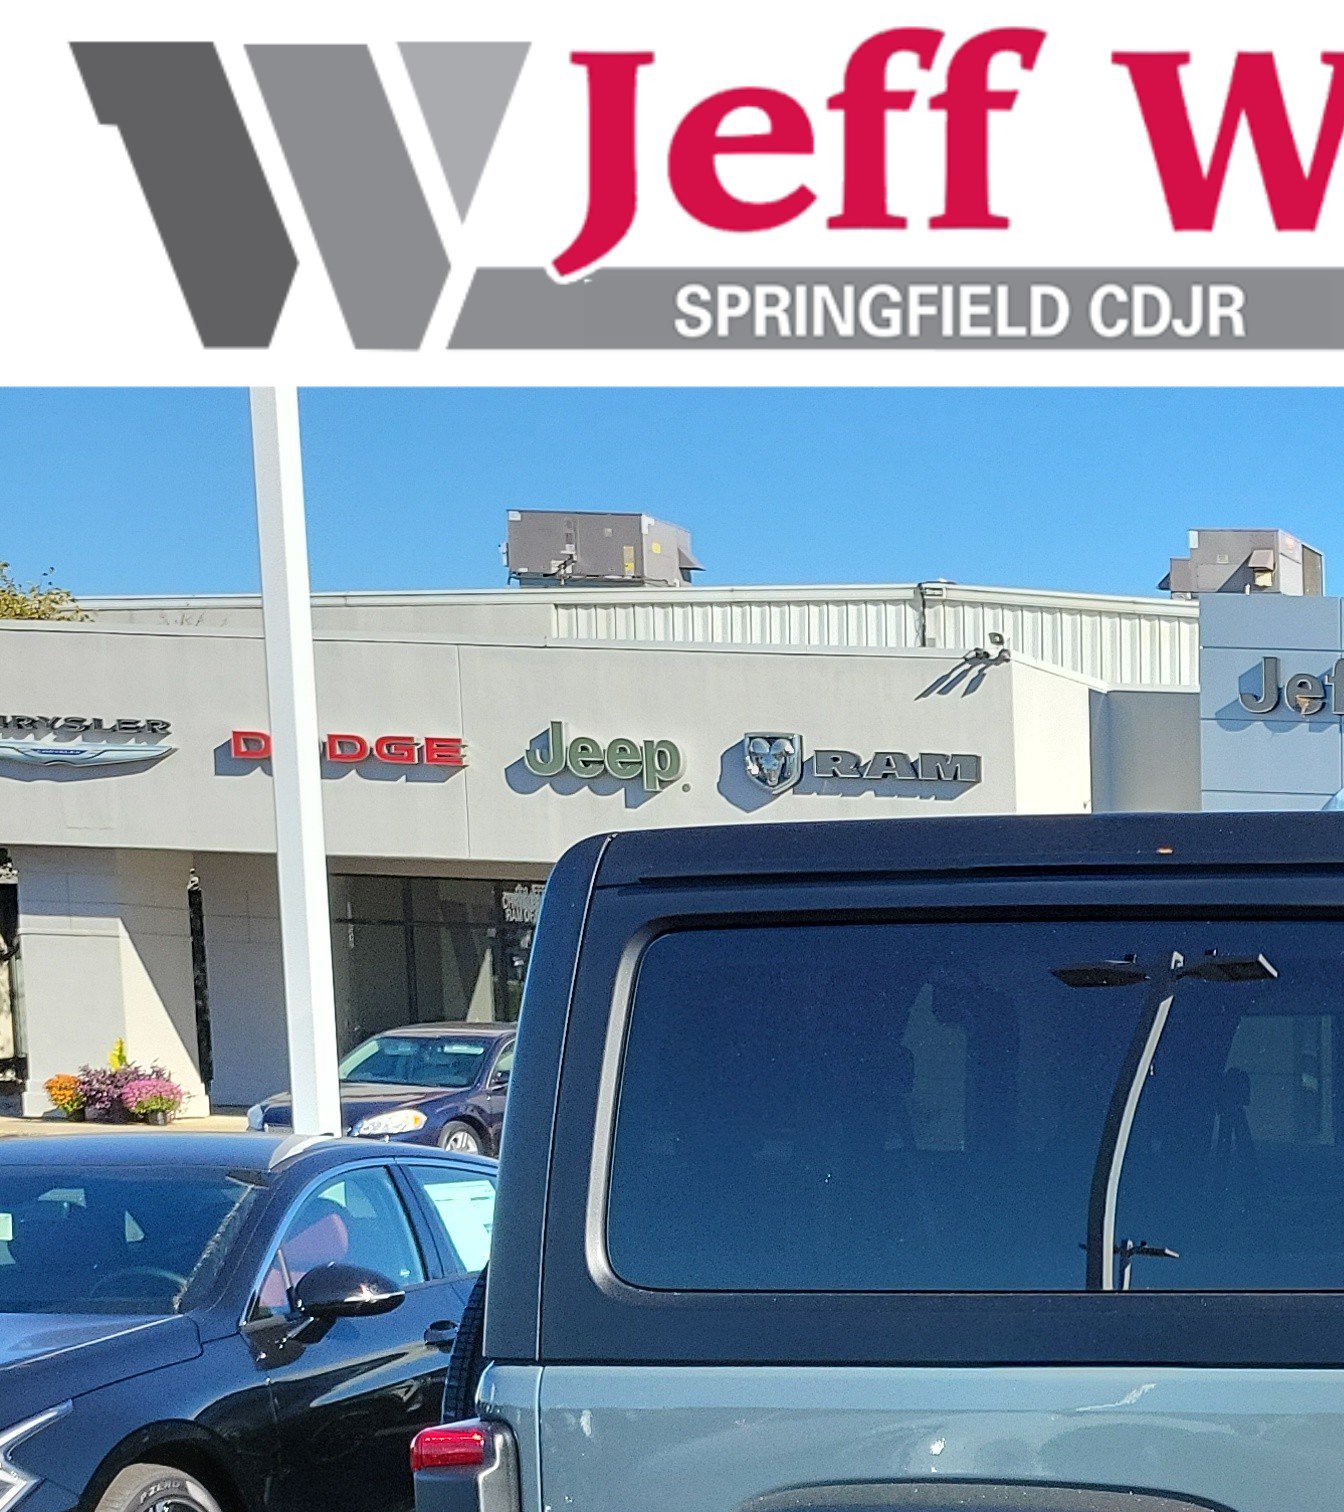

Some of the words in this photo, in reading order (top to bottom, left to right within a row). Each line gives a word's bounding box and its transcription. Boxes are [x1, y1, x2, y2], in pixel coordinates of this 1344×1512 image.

[0, 715, 172, 734] RYSLER
[231, 730, 467, 766] DDGE
[525, 720, 686, 791] Jeep
[813, 750, 982, 781] RAM
